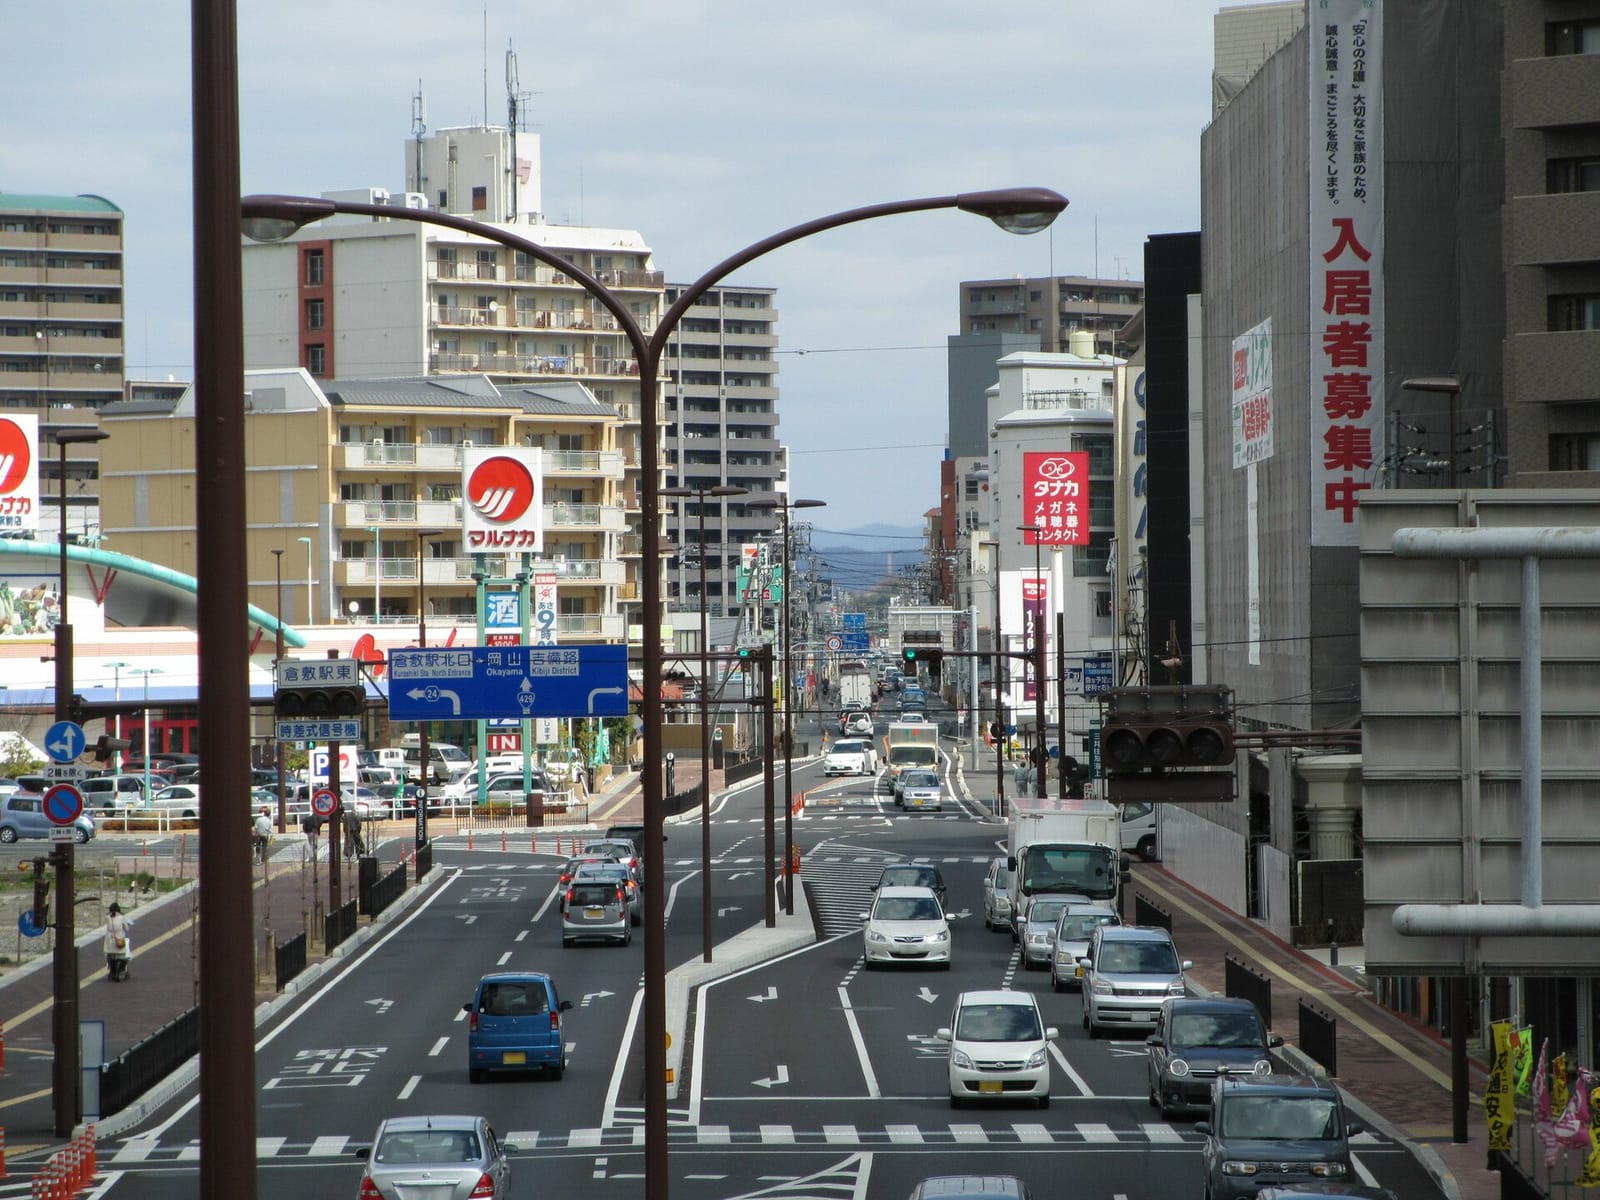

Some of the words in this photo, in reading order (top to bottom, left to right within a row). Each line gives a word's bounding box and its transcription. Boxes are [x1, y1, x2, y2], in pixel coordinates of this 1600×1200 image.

[1322, 217, 1372, 523] 入居者募集中
[1034, 480, 1079, 497] タナカ
[1034, 501, 1078, 514] メガネ
[1034, 515, 1079, 528] 補聴器
[468, 529, 535, 548] マルナカ
[1034, 529, 1079, 541] コンタクト
[487, 594, 519, 625] 酒
[537, 609, 555, 629] 9
[394, 653, 471, 667] 倉敷駅北口
[487, 652, 521, 666] 岡山
[532, 652, 577, 666] 吉備路
[284, 664, 351, 681] 倉敷駅東
[486, 668, 523, 677] Okayama
[532, 667, 550, 675] Kibiji
[552, 666, 577, 674] District
[428, 690, 437, 699] 24
[519, 695, 533, 703] 429
[280, 723, 357, 737] 時差式信号機
[492, 735, 517, 750] IN
[315, 754, 329, 775] P
